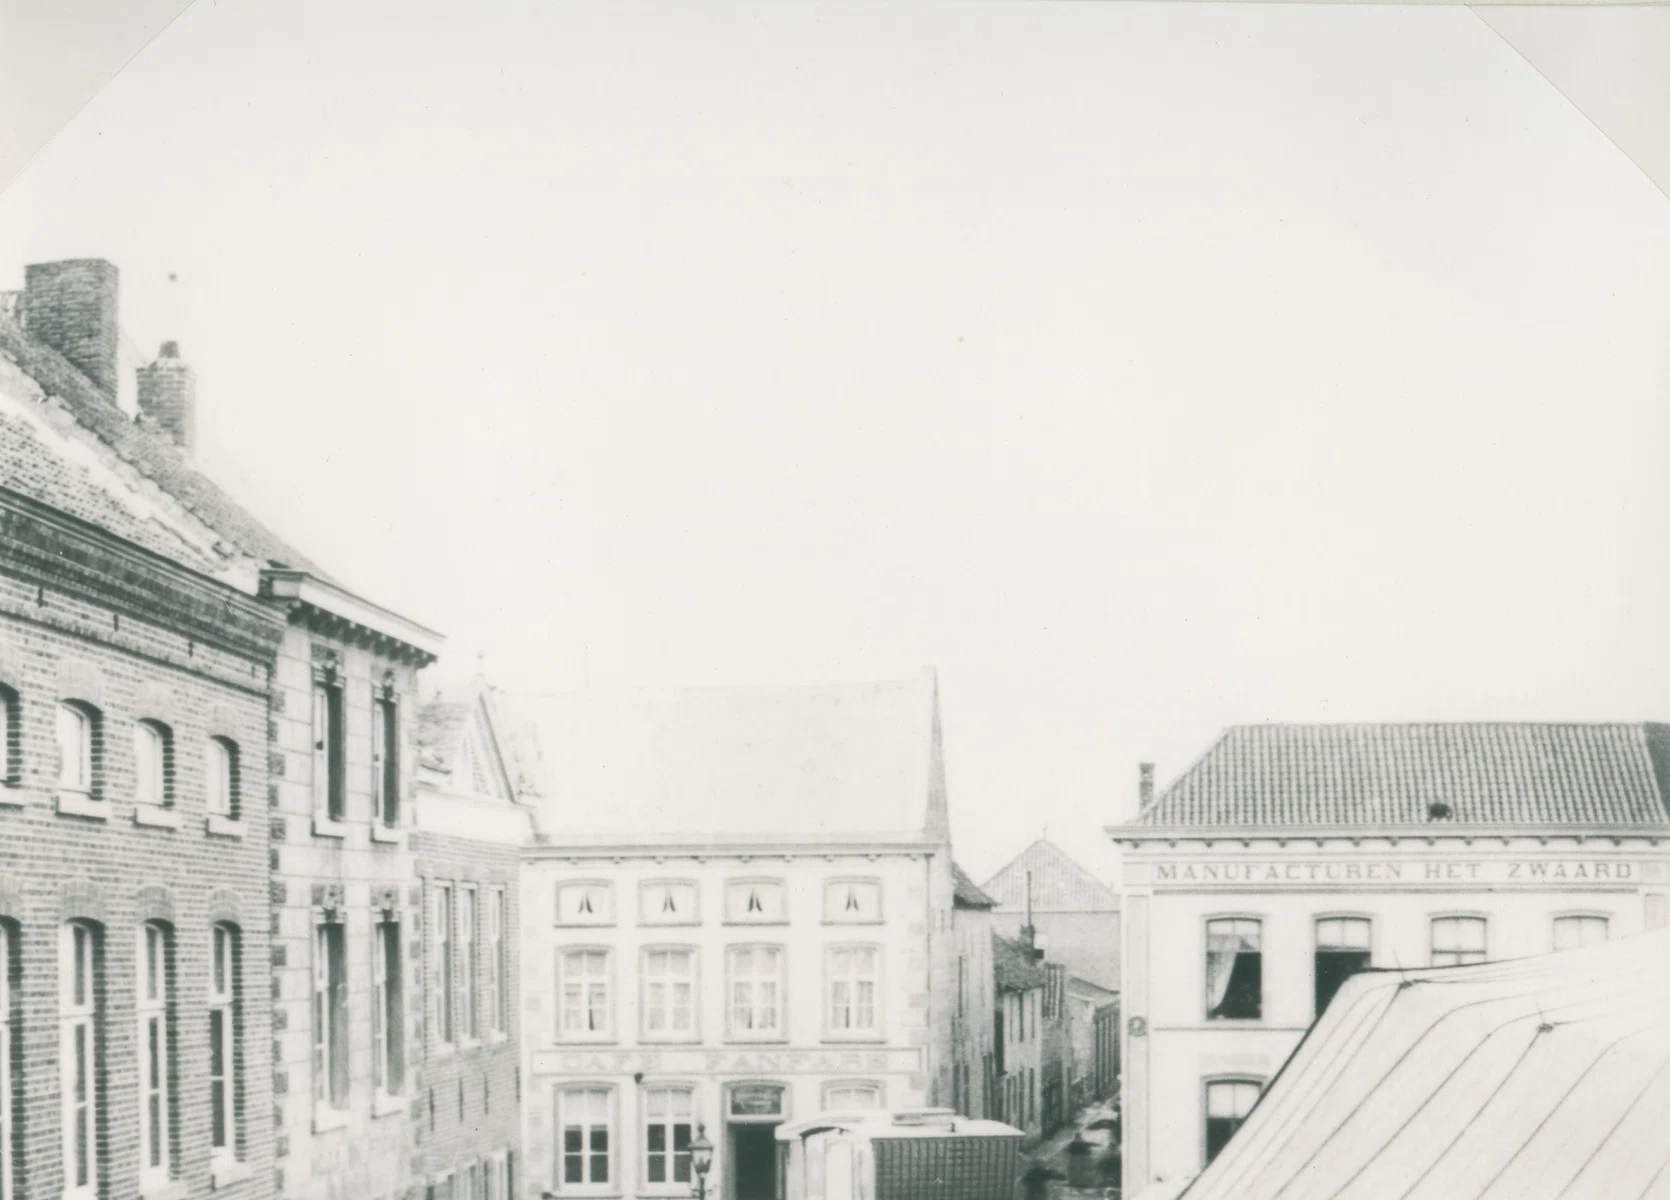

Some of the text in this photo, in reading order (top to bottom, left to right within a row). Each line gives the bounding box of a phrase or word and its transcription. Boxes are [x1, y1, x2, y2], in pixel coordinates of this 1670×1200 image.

[1156, 861, 1634, 881] MANUFACTUREN HET ZWAARD
